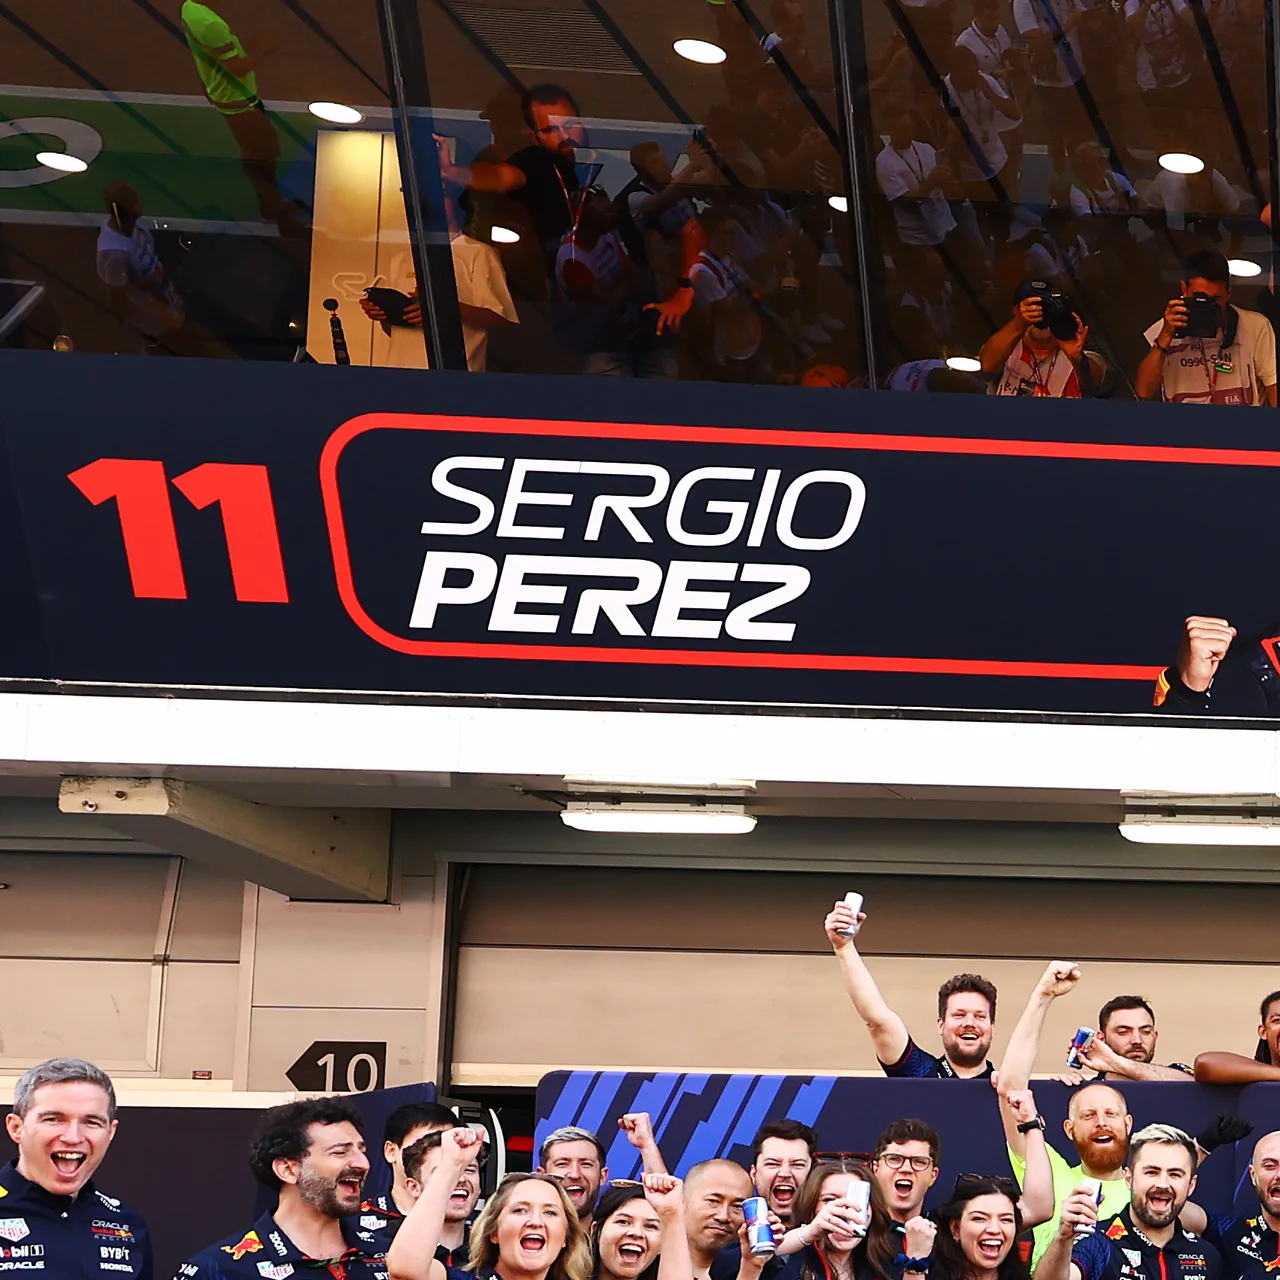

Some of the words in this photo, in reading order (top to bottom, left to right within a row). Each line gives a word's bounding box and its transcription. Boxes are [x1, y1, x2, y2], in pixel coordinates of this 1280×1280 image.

[1225, 395, 1240, 403] FIA
[420, 455, 867, 552] SERGIO
[66, 458, 290, 604] 11
[409, 551, 811, 643] PEREZ
[317, 1053, 378, 1092] 10
[92, 1219, 129, 1230] ORACLE
[100, 1246, 129, 1260] BYBIT
[269, 1231, 289, 1256] zoom
[100, 1262, 133, 1273] HONDA
